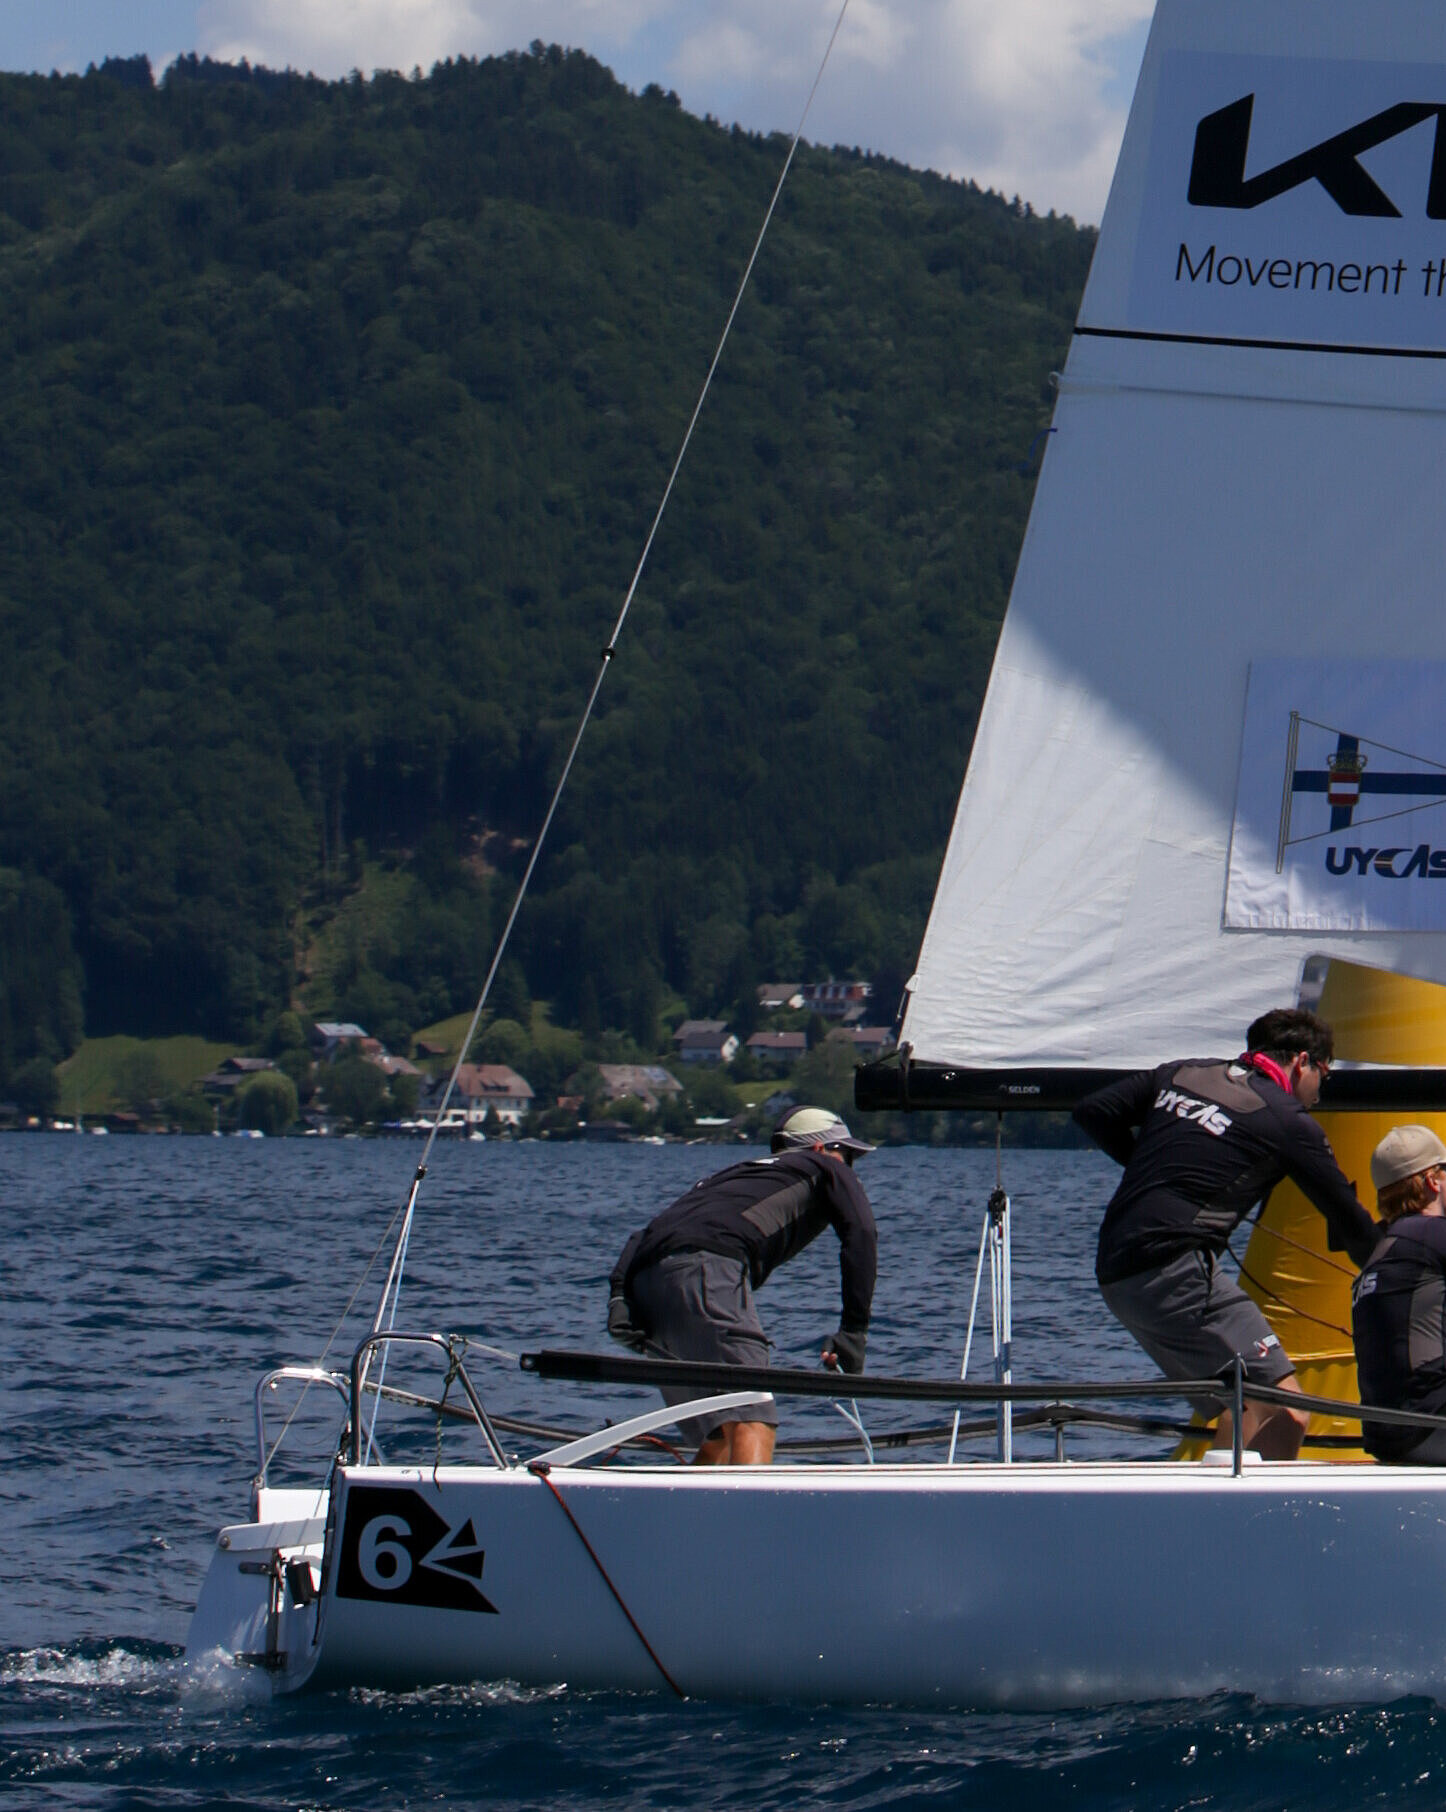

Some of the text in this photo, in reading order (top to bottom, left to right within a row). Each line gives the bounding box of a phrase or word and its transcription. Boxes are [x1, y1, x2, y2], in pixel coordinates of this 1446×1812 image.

[1174, 242, 1407, 295] Movement
[1153, 1089, 1233, 1136] UYCAS
[357, 1514, 413, 1591] 6
